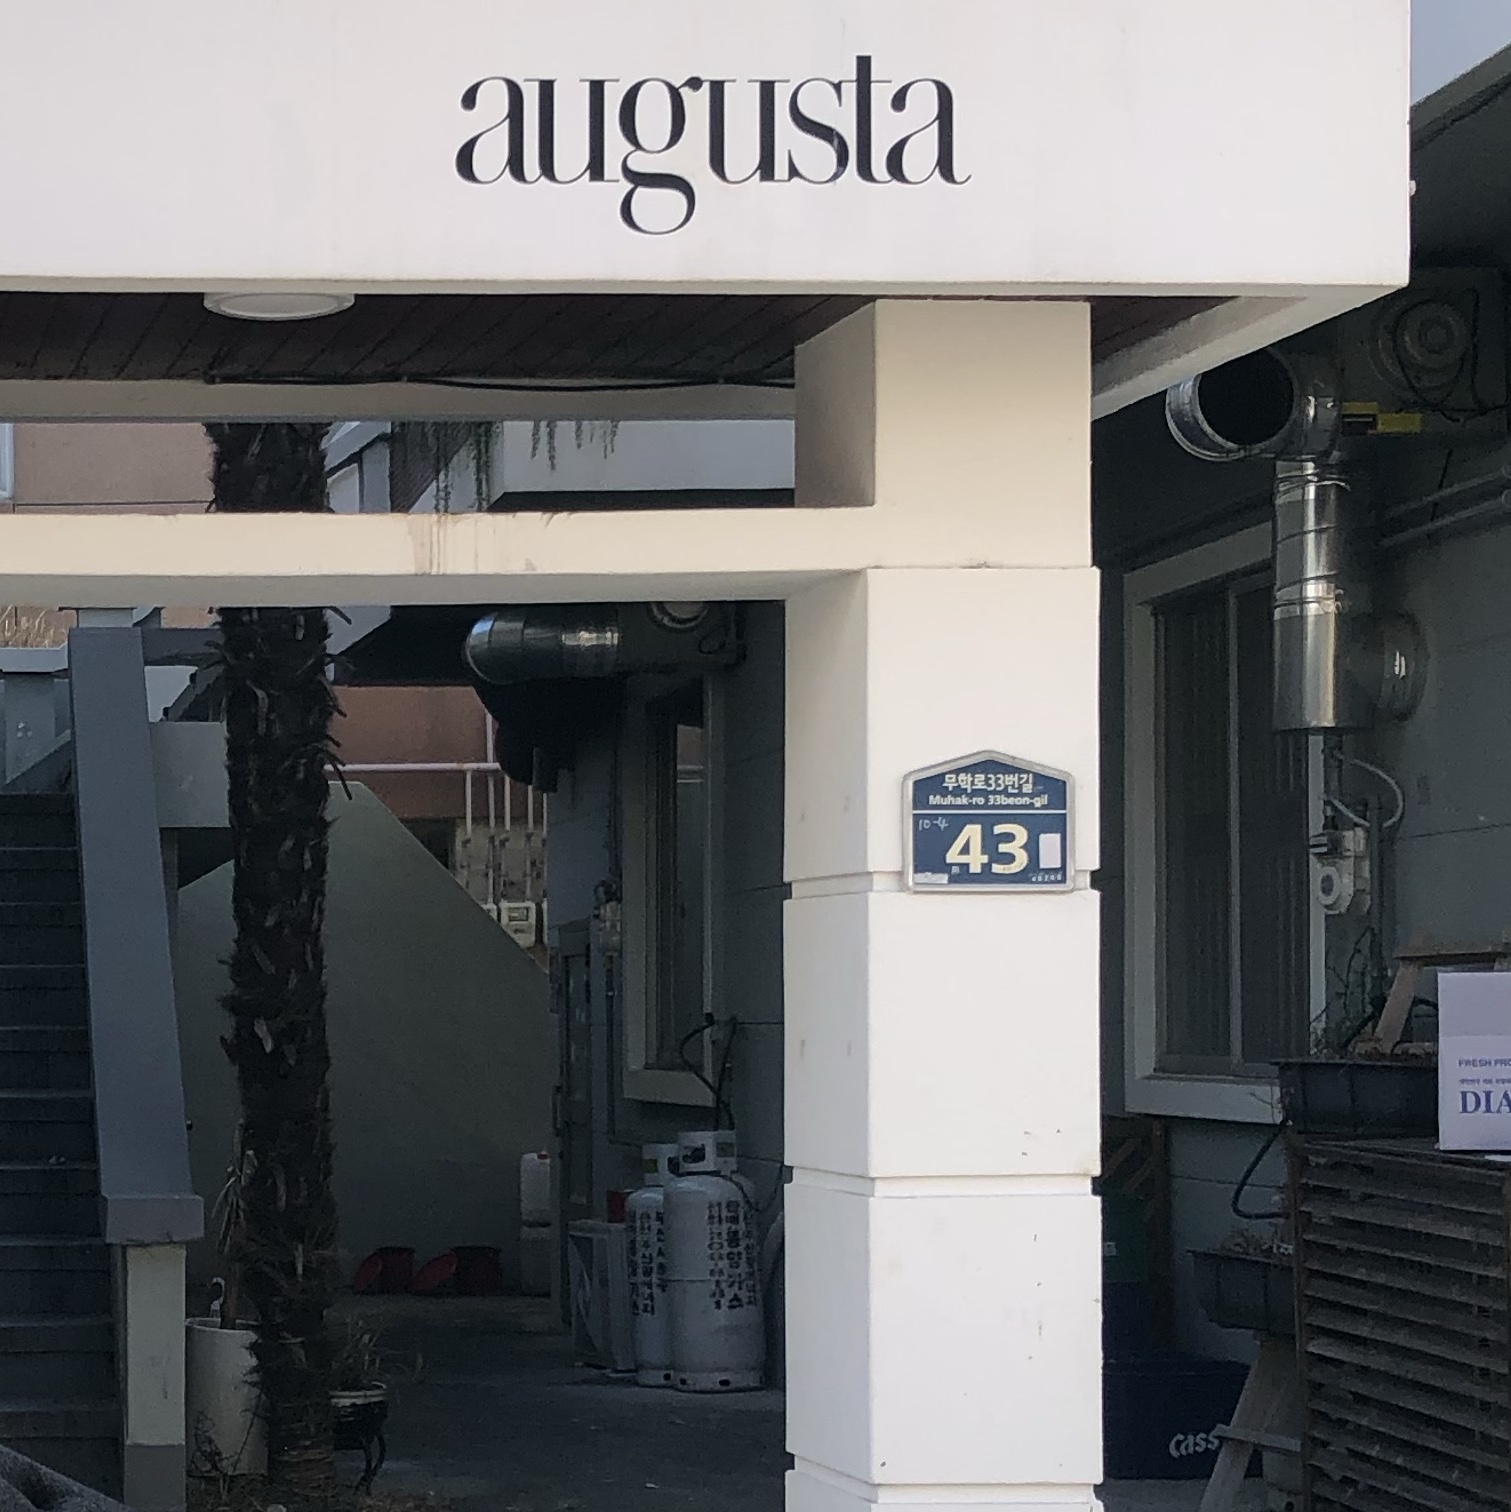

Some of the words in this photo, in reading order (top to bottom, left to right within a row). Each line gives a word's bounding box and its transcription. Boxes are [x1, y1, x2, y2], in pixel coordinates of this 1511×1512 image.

[454, 54, 972, 236] augusta
[943, 772, 1033, 793] 무학로33번길
[929, 795, 984, 806] Muhak-ro
[988, 795, 1048, 807] 33beon-gil
[945, 823, 1029, 875] 43
[1458, 1058, 1492, 1067] FRESH
